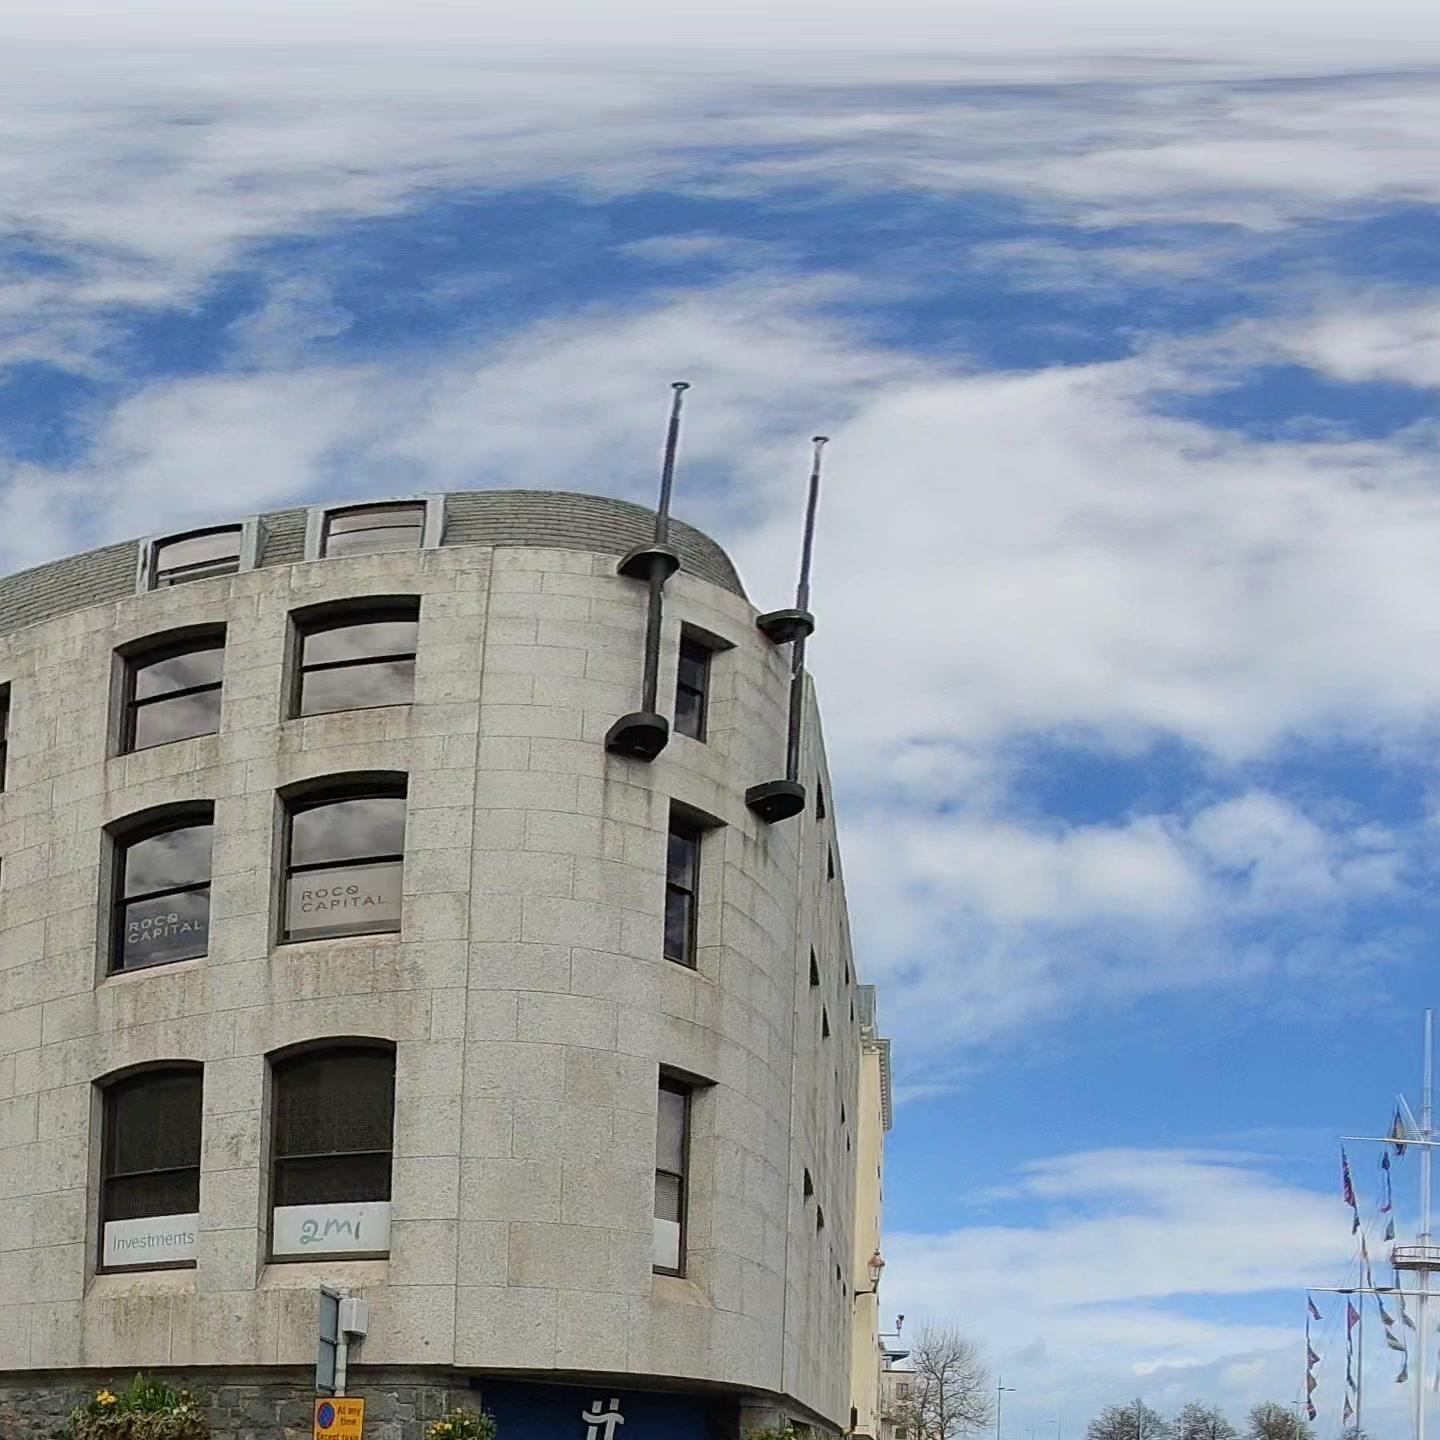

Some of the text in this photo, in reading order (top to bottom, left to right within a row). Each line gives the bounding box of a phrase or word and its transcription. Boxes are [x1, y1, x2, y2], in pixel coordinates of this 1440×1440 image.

[302, 885, 360, 900] ROCQ
[302, 895, 385, 913] CAPITAL
[128, 912, 179, 932] ROCQ
[128, 923, 201, 944] CAPITAL
[112, 1231, 195, 1251] Investments
